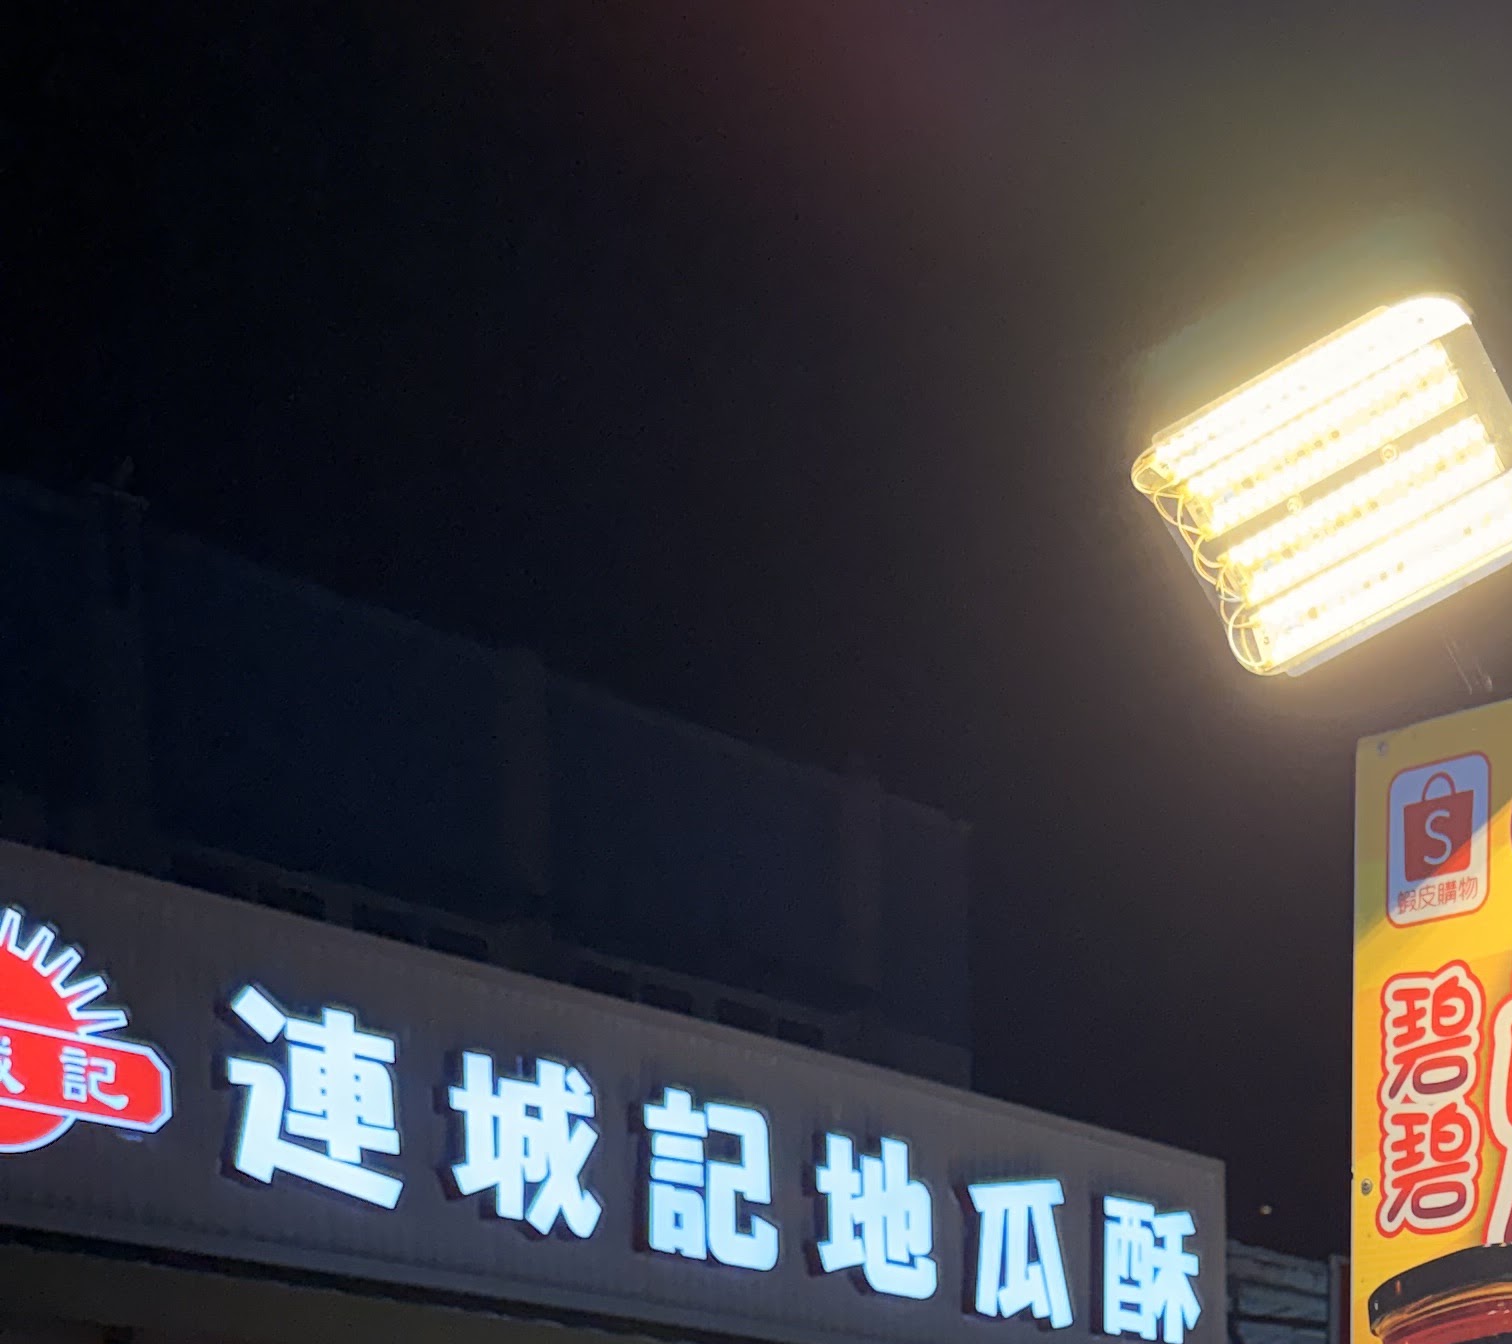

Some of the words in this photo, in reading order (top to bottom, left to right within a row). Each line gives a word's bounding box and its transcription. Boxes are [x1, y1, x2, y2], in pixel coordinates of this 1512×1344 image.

[1396, 874, 1480, 917] 蝦皮購物
[1382, 968, 1484, 1232] 碧碧
